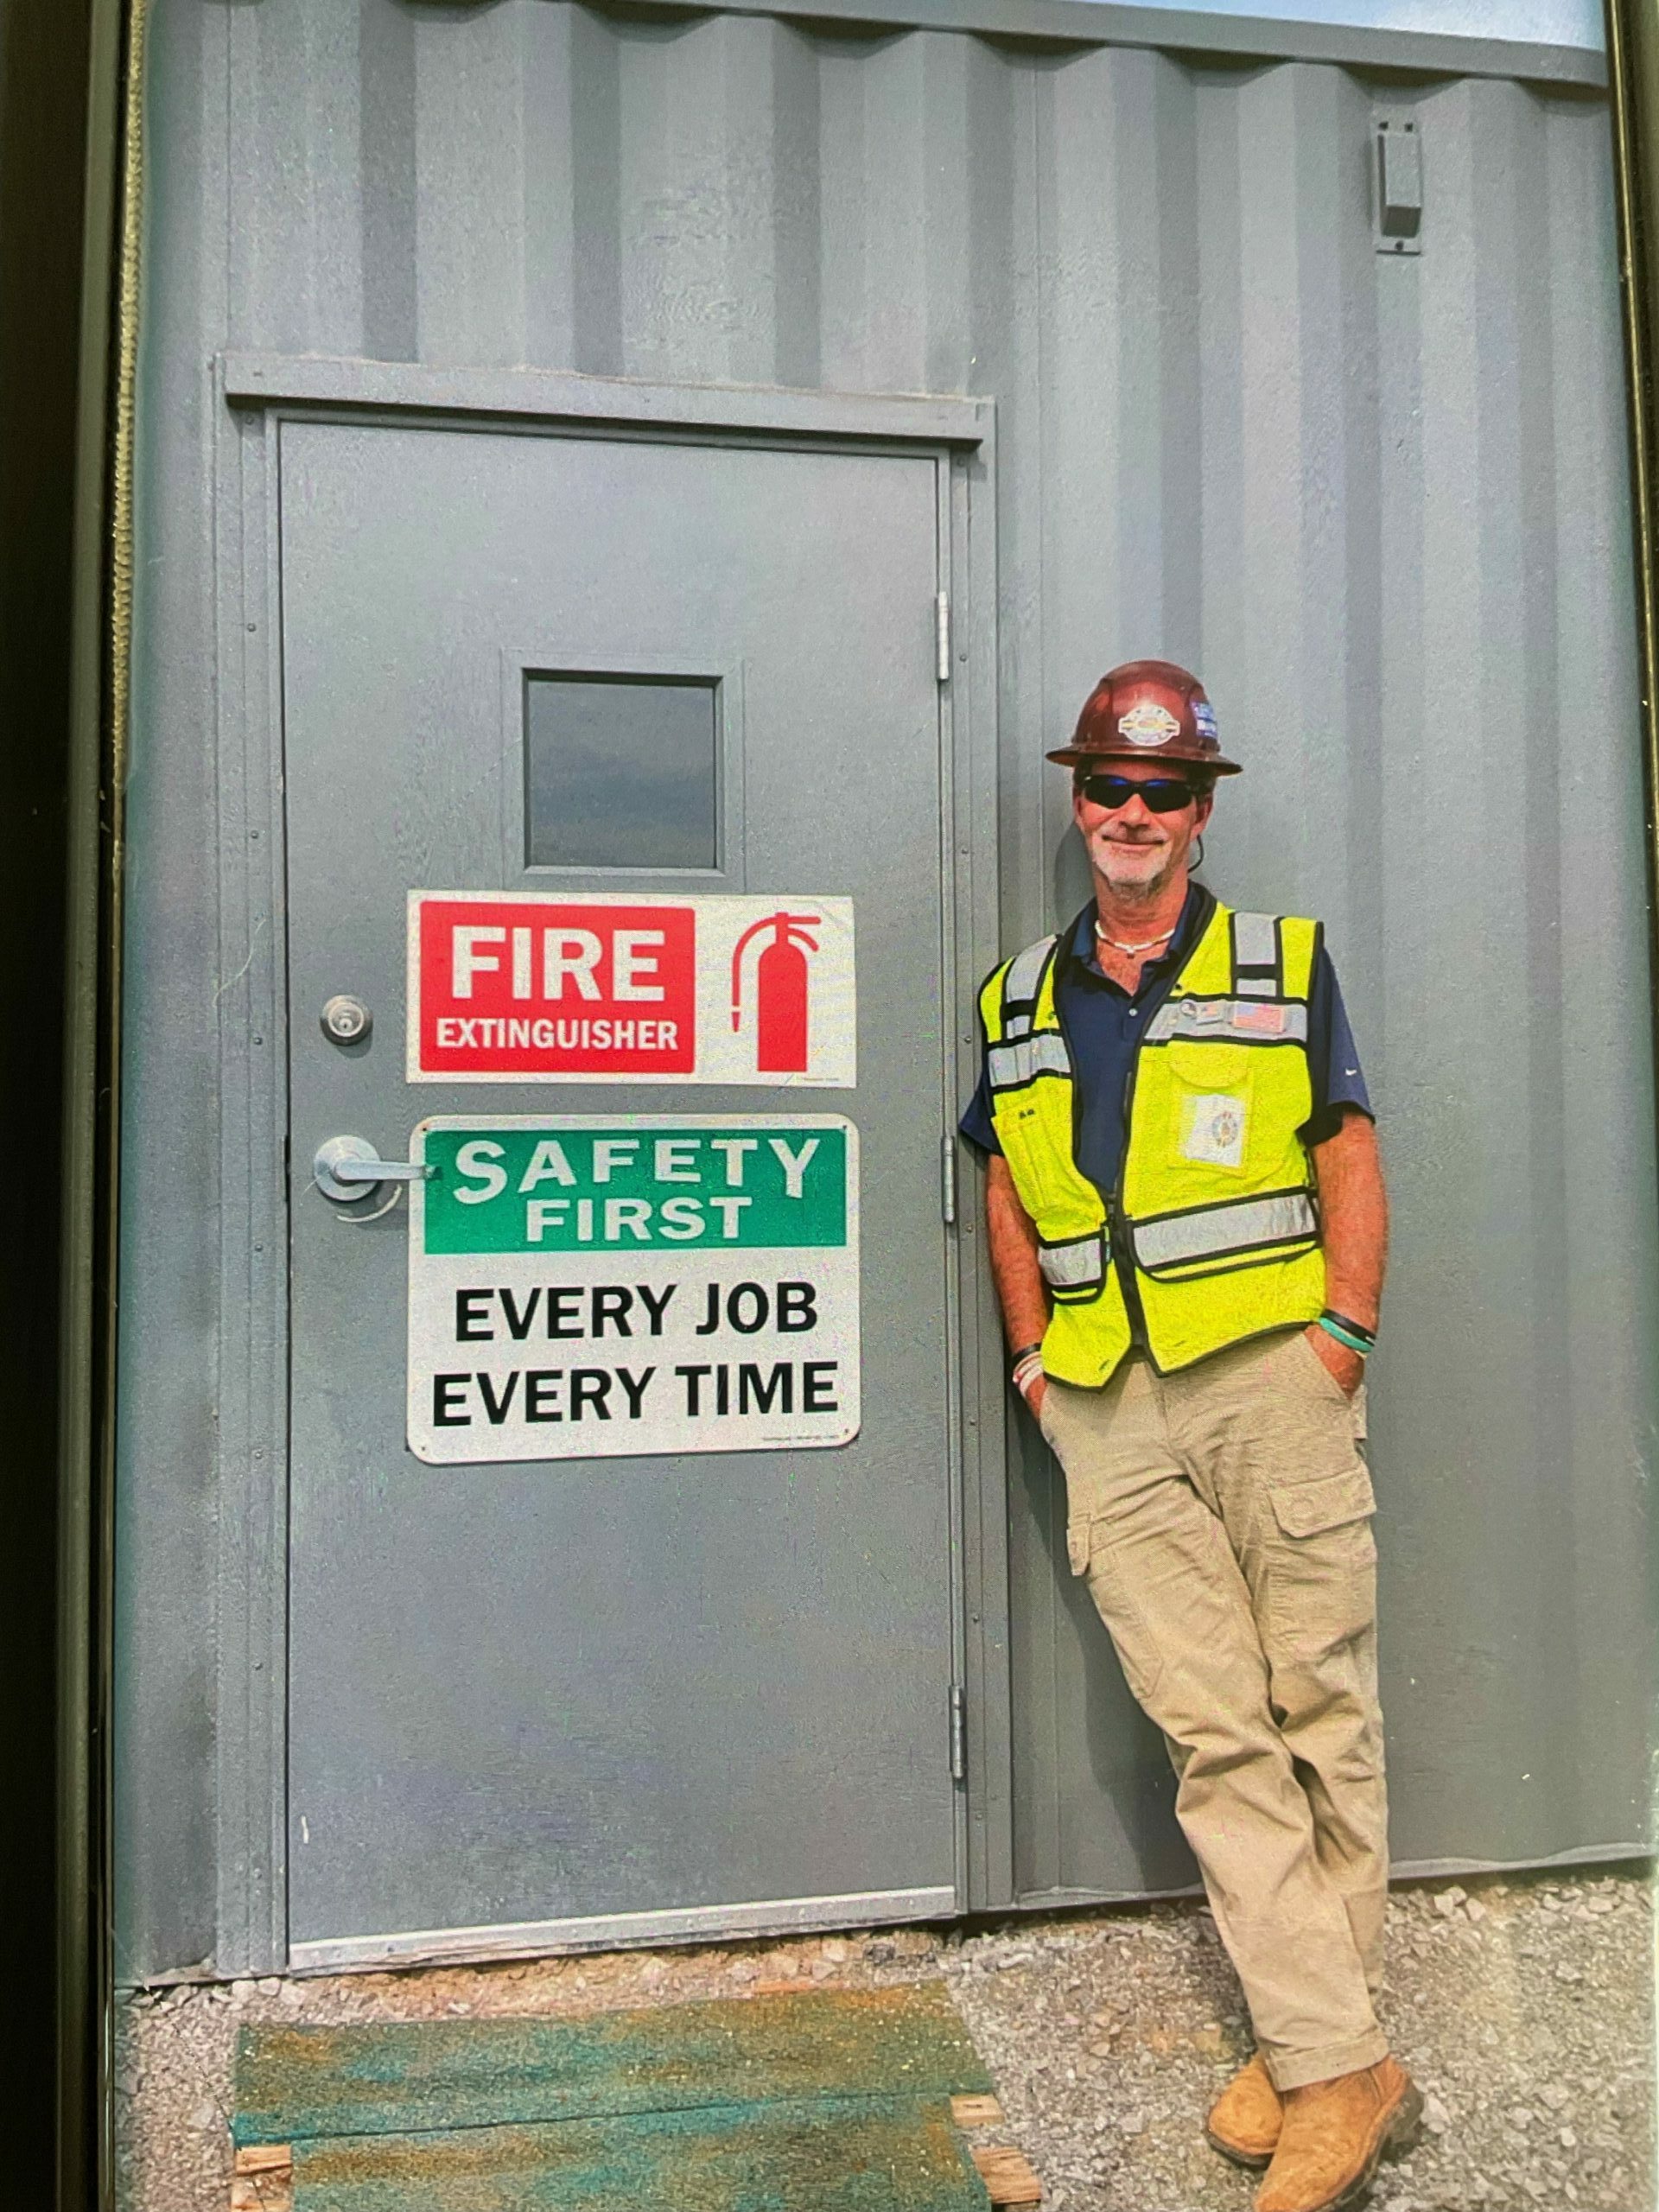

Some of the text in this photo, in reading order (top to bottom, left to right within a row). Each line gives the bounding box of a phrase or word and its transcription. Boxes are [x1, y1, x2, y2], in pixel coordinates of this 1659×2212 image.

[452, 925, 665, 1001] FIRE
[436, 1017, 677, 1050] EXTINGUISHER
[453, 1138, 820, 1205] SAFETY
[526, 1196, 753, 1243] FIRST
[455, 1281, 817, 1342] EVERY JOB
[433, 1361, 838, 1427] EVERY TIME
